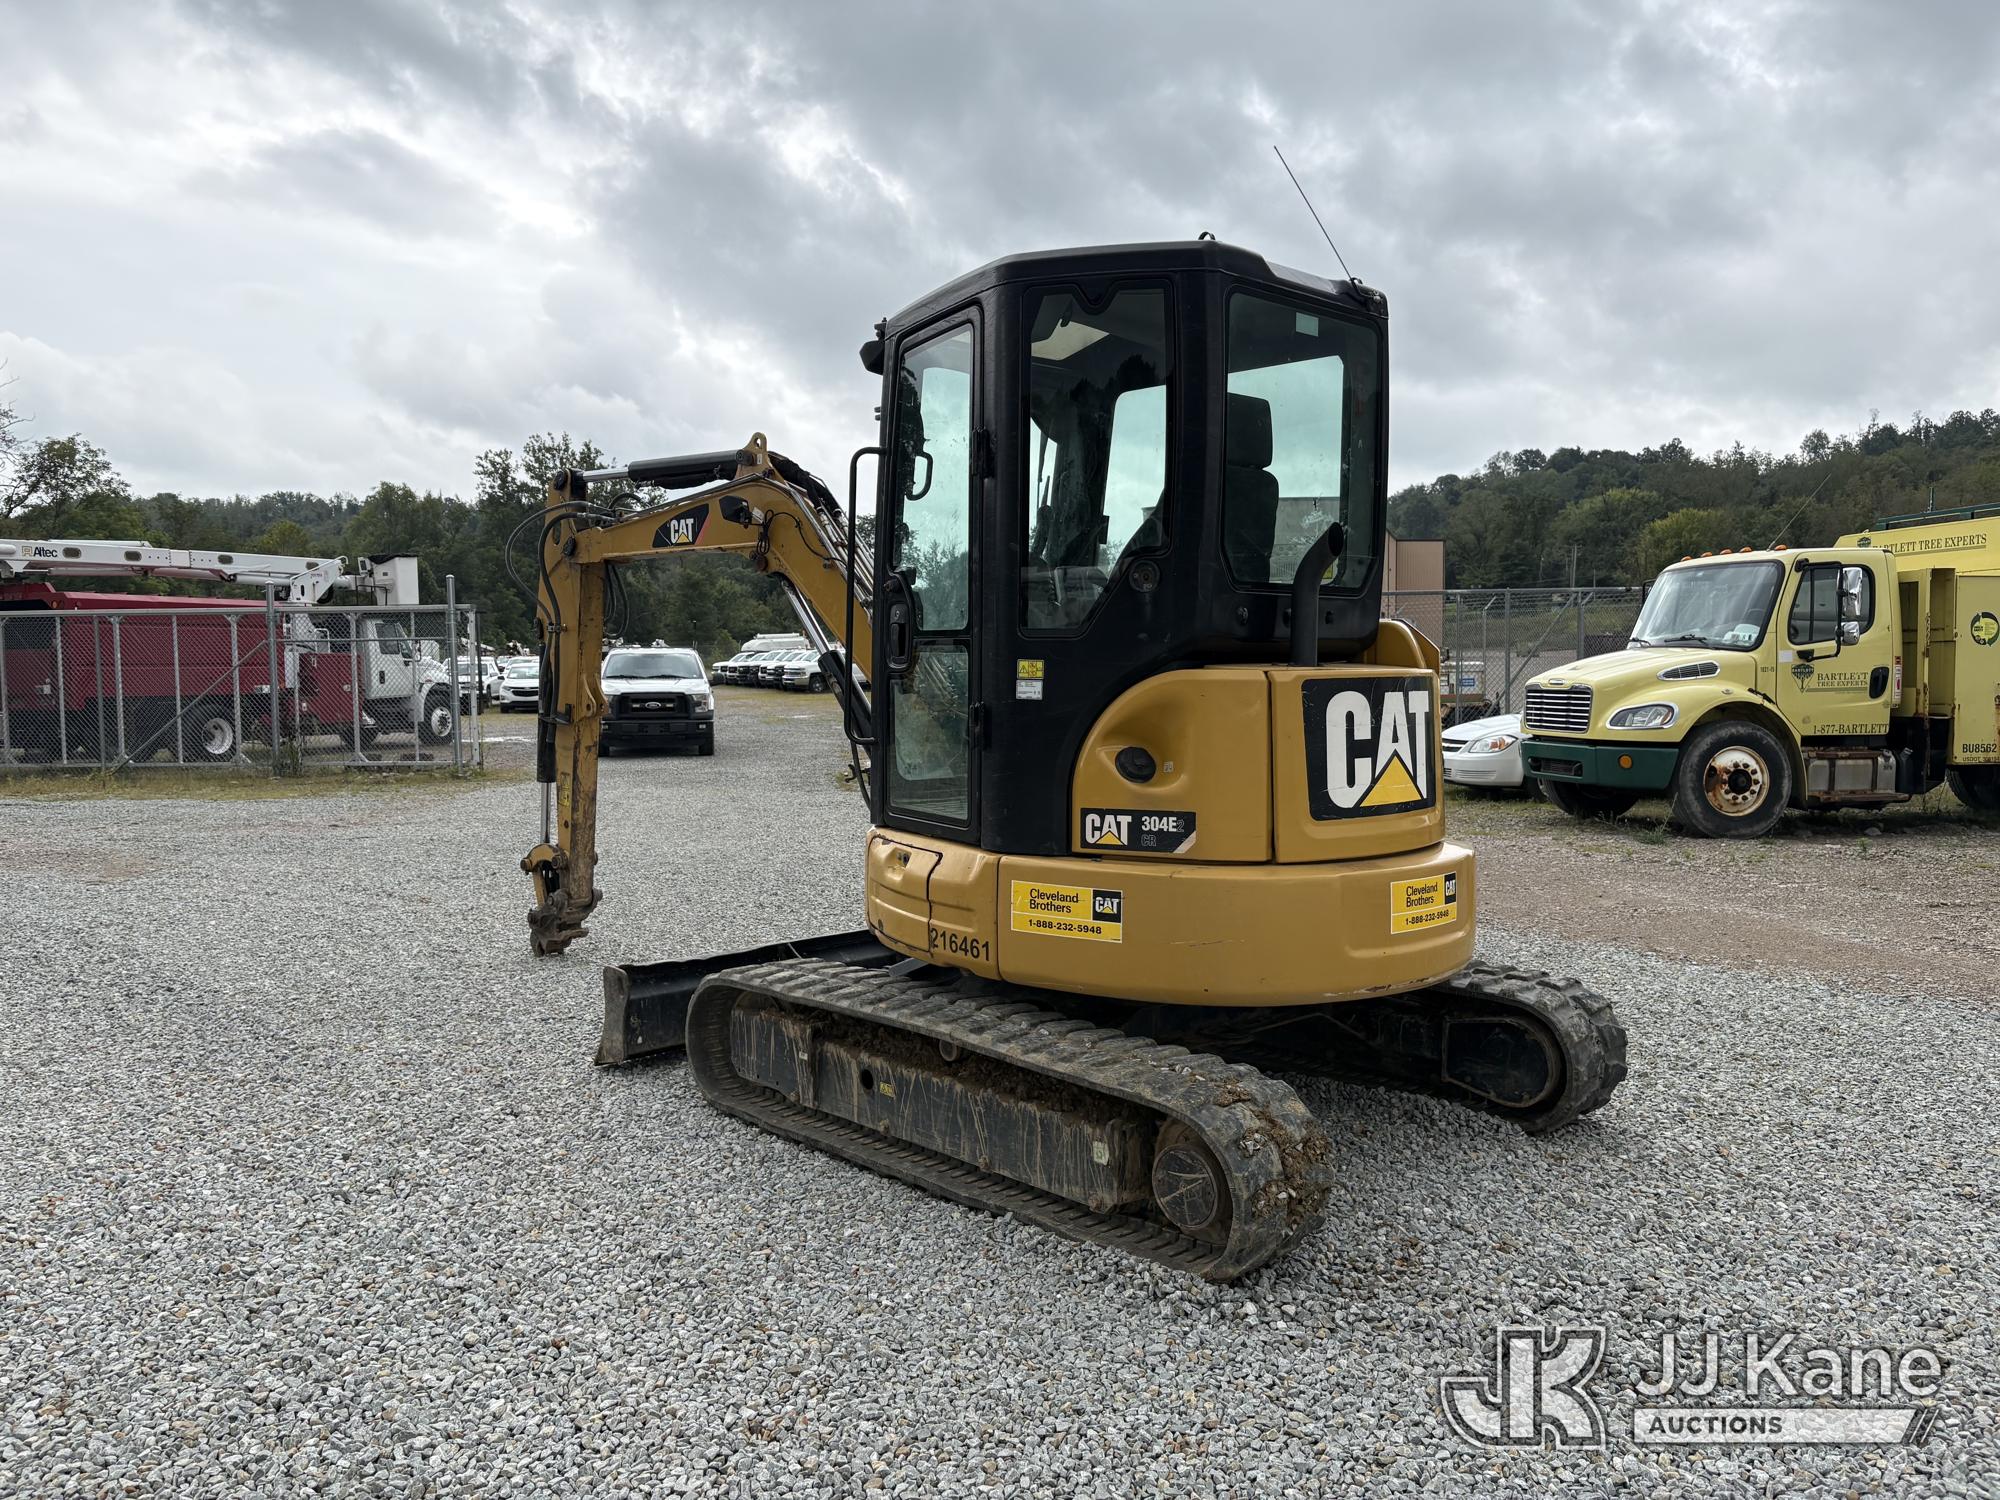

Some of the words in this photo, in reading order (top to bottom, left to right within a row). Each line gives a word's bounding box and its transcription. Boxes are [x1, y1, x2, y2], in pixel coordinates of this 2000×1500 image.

[670, 518, 694, 544] CAT
[1918, 538, 1943, 550] TREE
[1944, 533, 1987, 548] EXPERTS
[33, 546, 58, 558] Altec
[1817, 672, 1868, 681] BARTLETT
[1813, 723, 1888, 734] 1-877-BARTLETT
[1325, 690, 1430, 808] CAT
[1962, 743, 1997, 753] BU8562
[1085, 813, 1132, 846] CAT
[1141, 815, 1185, 833] 304E2
[1140, 834, 1157, 847] CR
[1029, 888, 1079, 903] Cleveland
[1406, 882, 1438, 897] Cleveland
[1445, 879, 1456, 896] CAT
[1029, 899, 1072, 914] Brothers
[1095, 896, 1120, 914] CAT
[1406, 894, 1434, 908] Brothers
[1405, 909, 1449, 926] 1-888-232-5948
[1028, 918, 1102, 935] 1-888-232-5948
[930, 927, 990, 962] 216461
